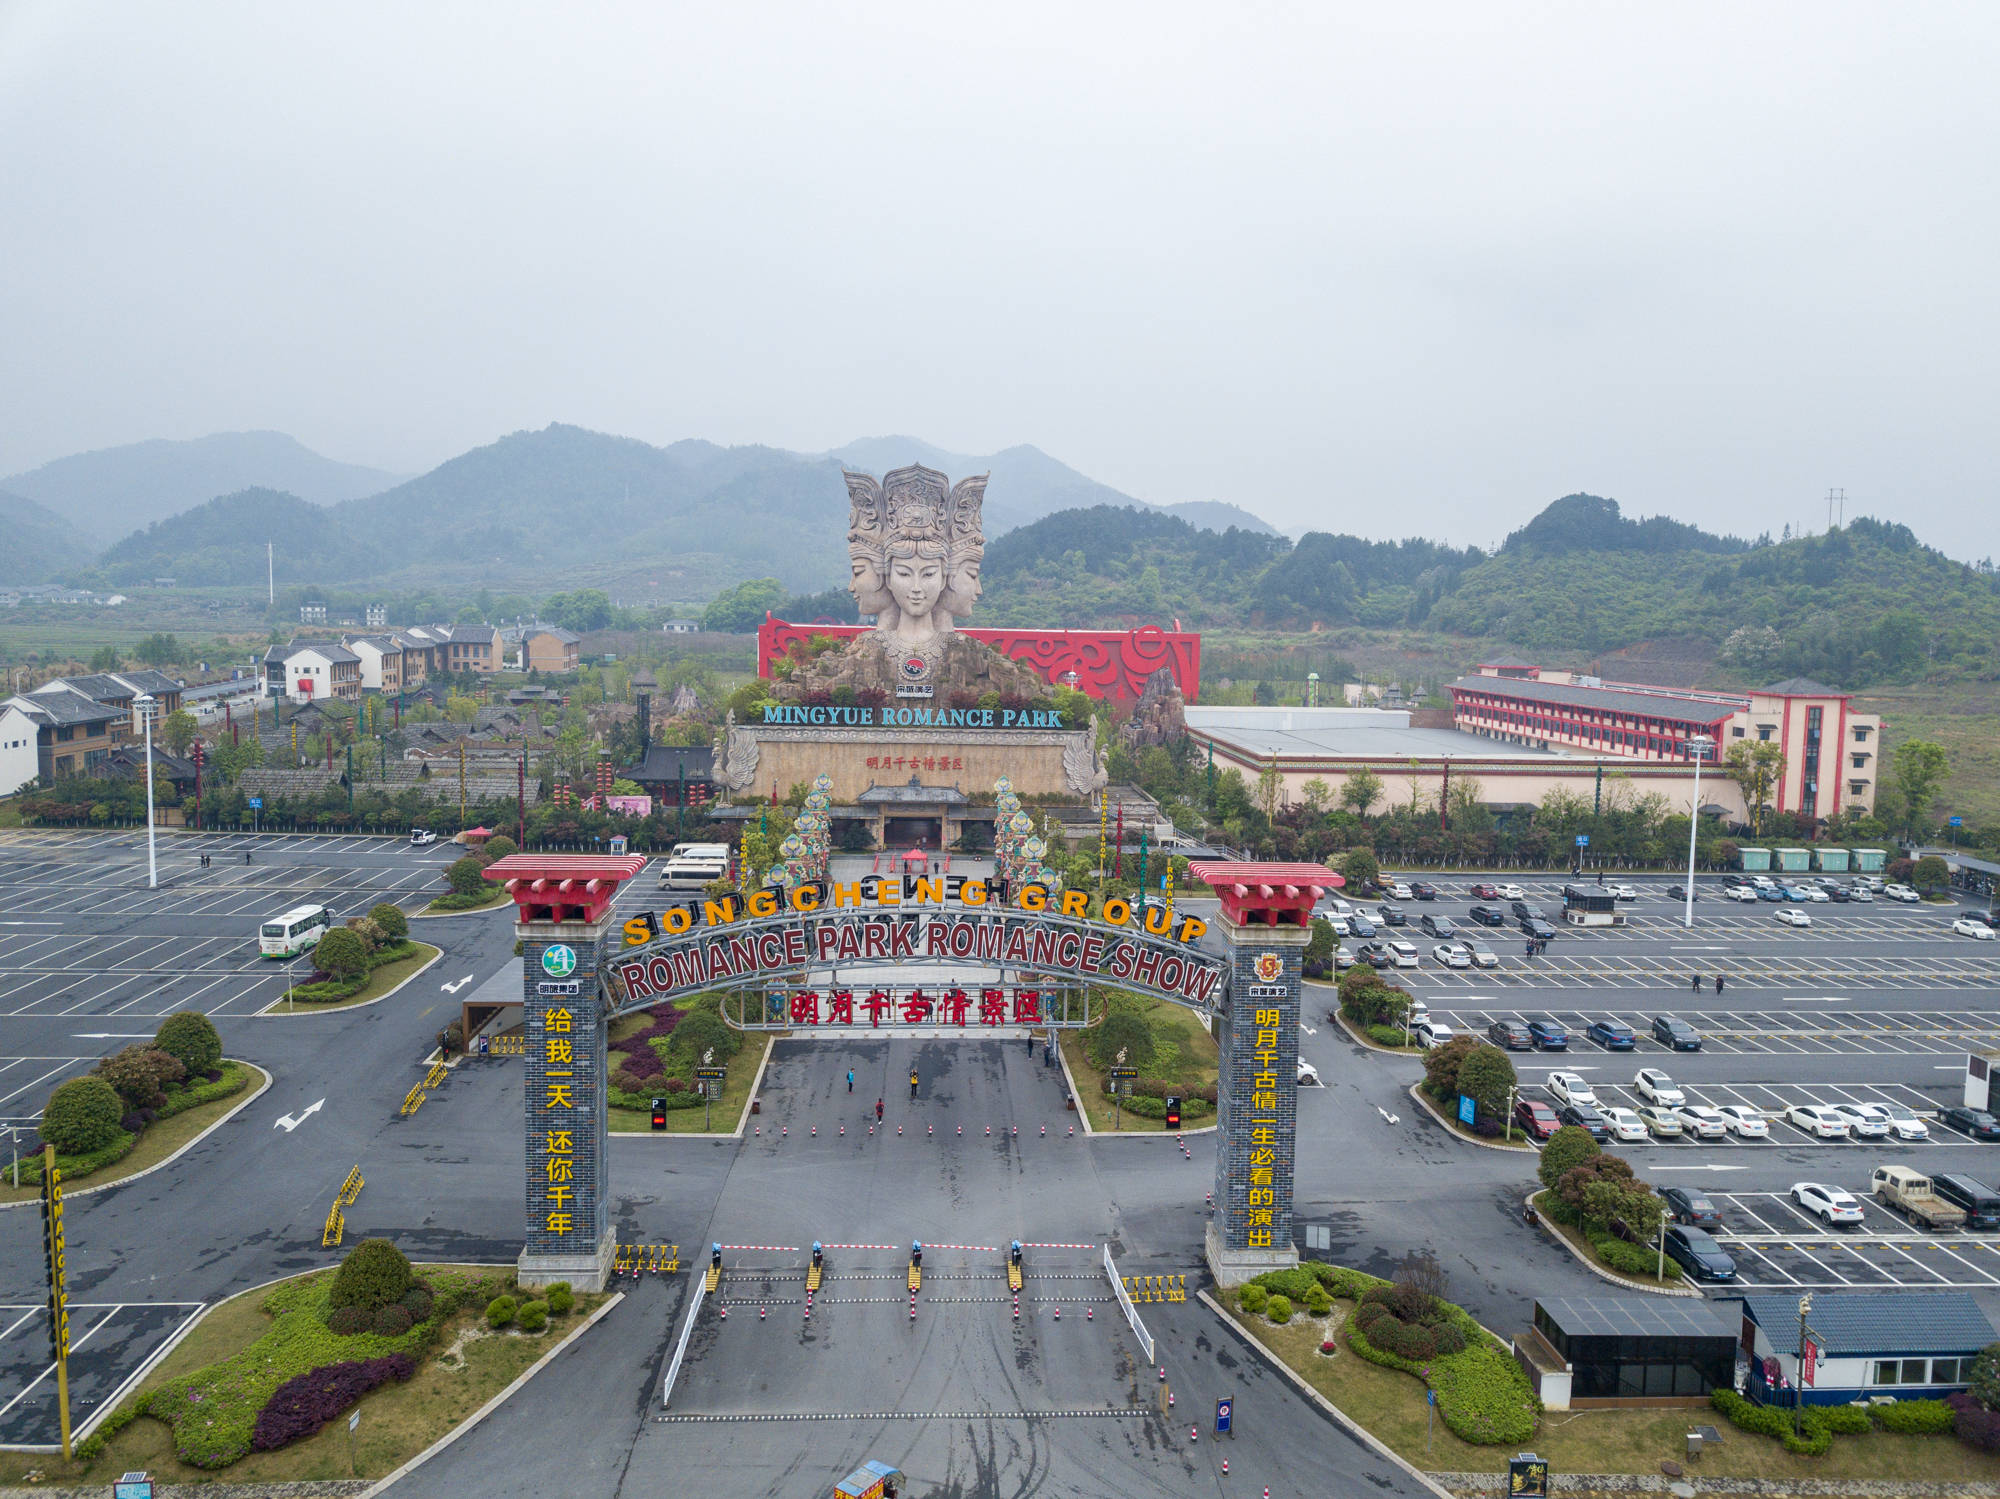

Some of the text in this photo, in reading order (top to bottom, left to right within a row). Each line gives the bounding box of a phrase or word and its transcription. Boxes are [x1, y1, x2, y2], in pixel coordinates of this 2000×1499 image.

[763, 705, 1063, 728] MINGYUE ROMANCE PARK
[866, 756, 963, 771] 明月千古情景区
[623, 878, 987, 945] SONGCHENG
[1019, 886, 1208, 943] GROUP
[620, 921, 1219, 1002] ROMANCE PARK ROMANCE SHOW
[790, 990, 1042, 1028] 明月千古情景区
[545, 1008, 573, 1109] 给我一天
[545, 1130, 574, 1236] 还你千年
[52, 1168, 70, 1359] ROMANCE PARK
